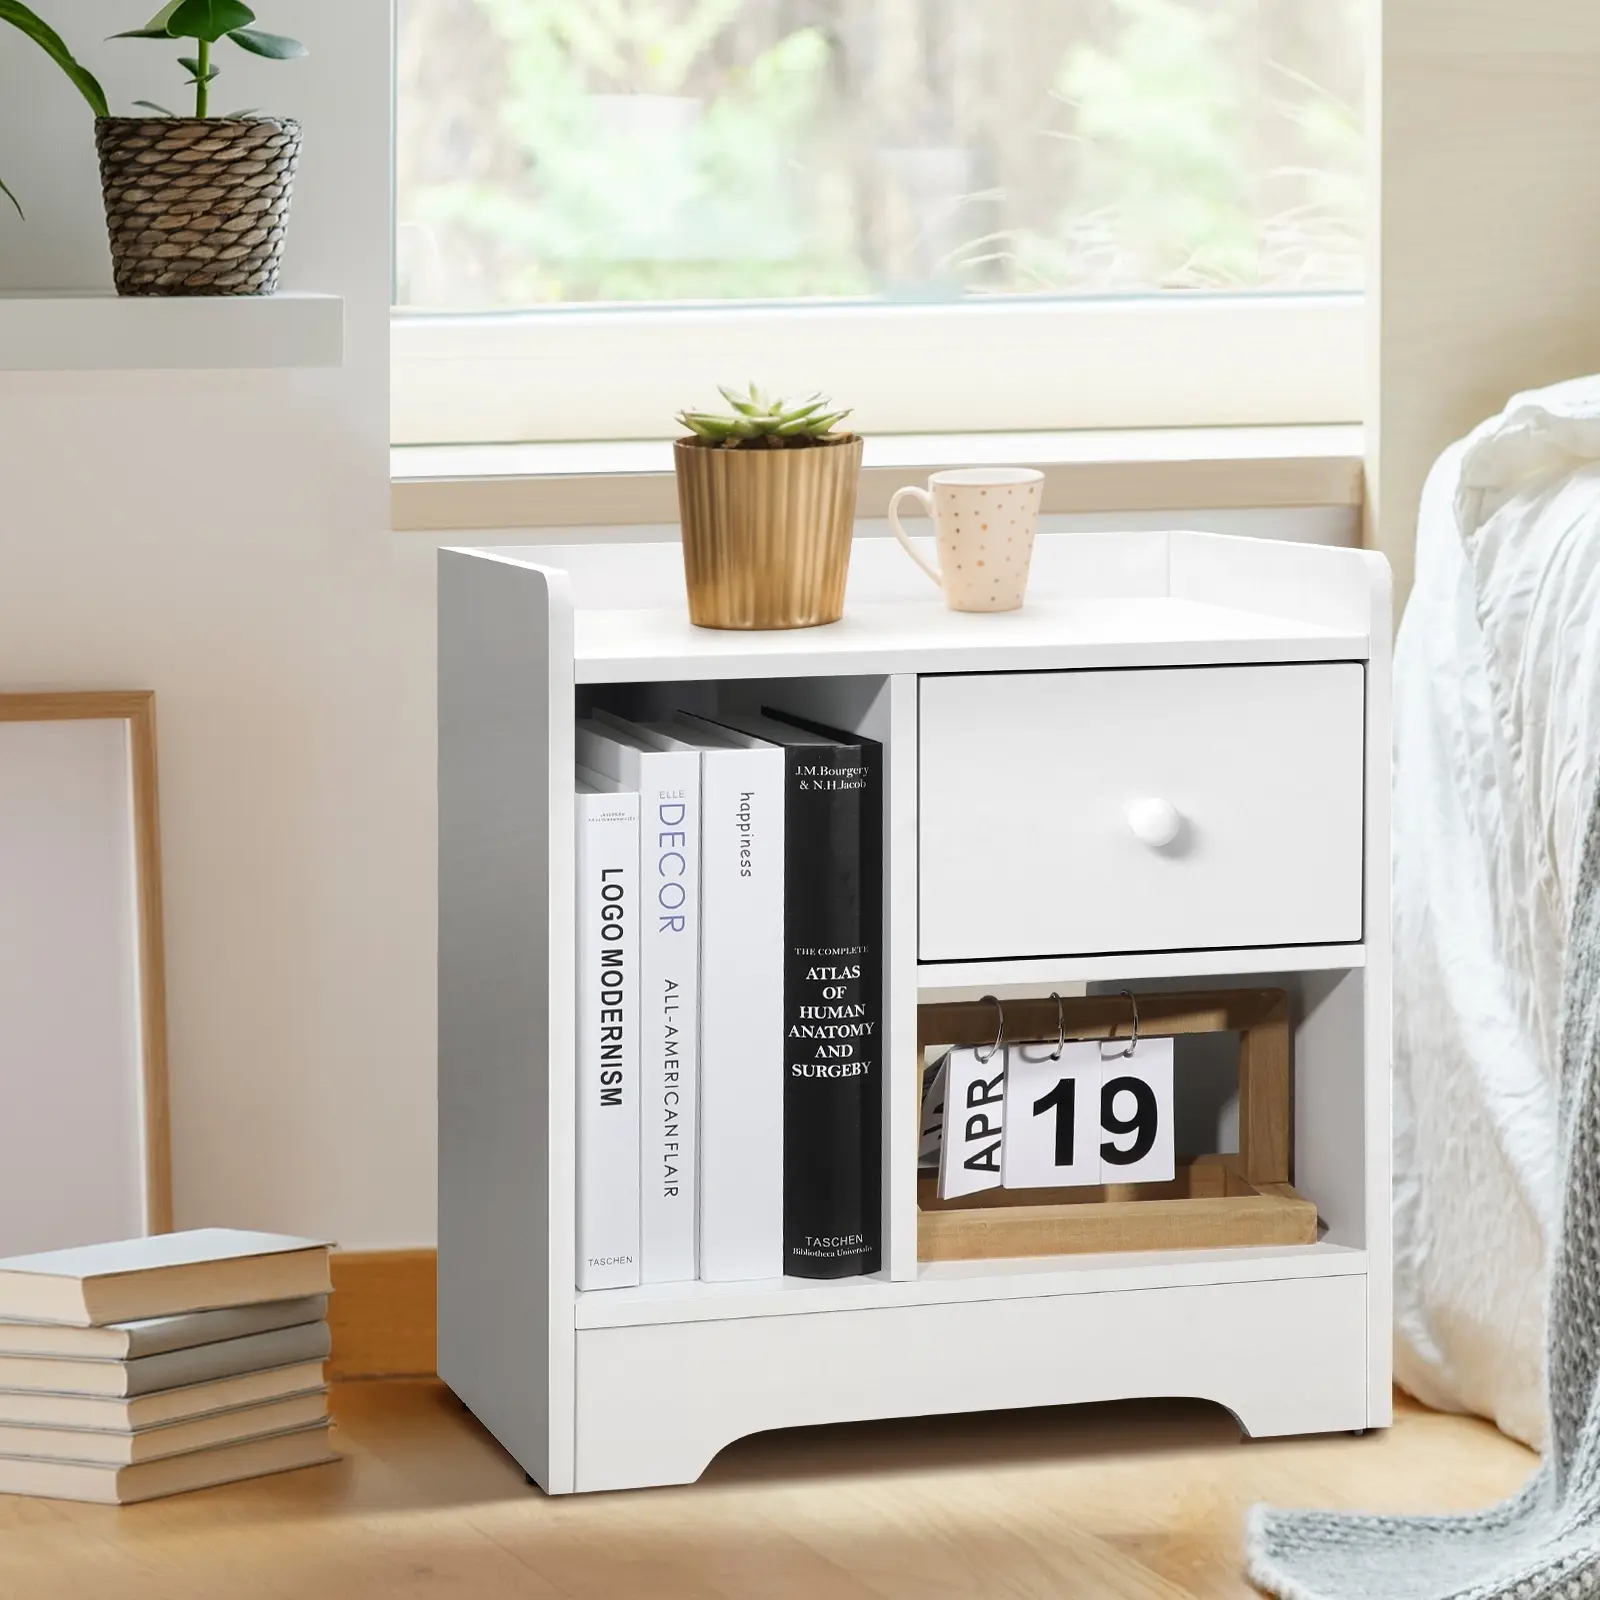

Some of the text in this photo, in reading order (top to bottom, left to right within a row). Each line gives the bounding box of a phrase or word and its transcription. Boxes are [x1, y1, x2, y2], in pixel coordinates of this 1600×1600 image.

[795, 766, 869, 778] J.M.Bourgery
[800, 780, 809, 790] &
[659, 790, 685, 799] ELLE
[736, 792, 755, 877] happiness
[659, 803, 686, 933] DECOR
[794, 946, 869, 956] THE COMPLETE
[806, 965, 861, 980] ATLAS
[600, 868, 624, 1107] LOGO MODERNISM
[822, 986, 847, 1000] OF
[800, 1003, 866, 1019] HUMAN
[788, 1021, 875, 1039] ANATOMY
[814, 1044, 854, 1059] AND
[964, 1070, 1004, 1173] APR
[1032, 1076, 1158, 1166] 19
[805, 1234, 863, 1248] TASCHEN
[588, 1255, 633, 1267] TASCHEN
